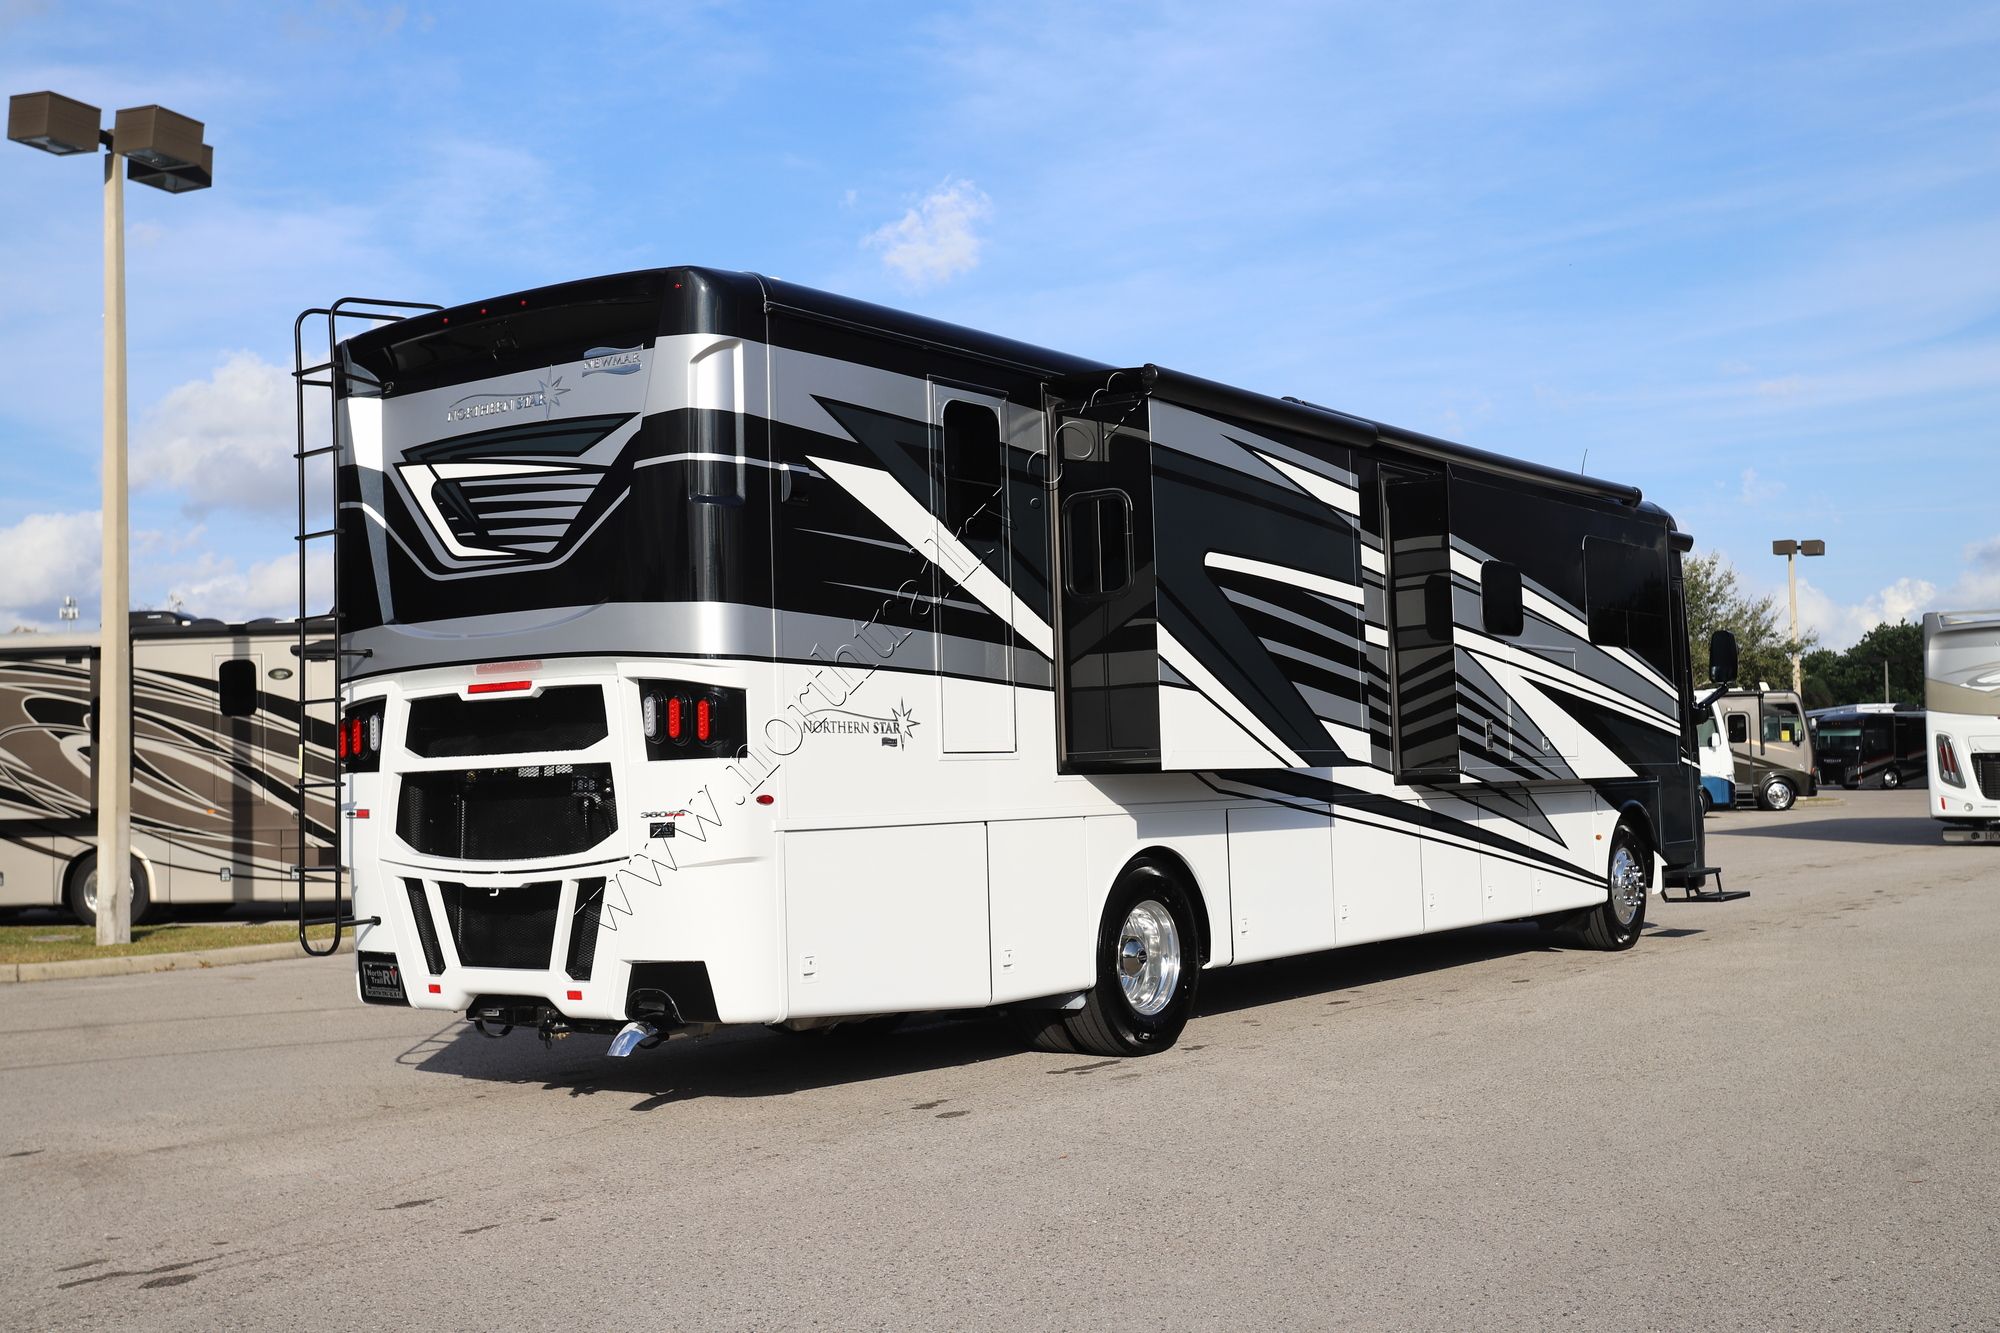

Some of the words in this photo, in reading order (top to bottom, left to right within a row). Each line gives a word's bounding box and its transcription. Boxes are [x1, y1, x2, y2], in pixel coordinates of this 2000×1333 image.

[583, 352, 641, 369] NEWMAR
[448, 398, 514, 422] NORTHERN
[516, 394, 548, 409] STAR
[803, 720, 870, 734] NORTHERN
[873, 722, 901, 734] STAR
[382, 970, 398, 985] RV
